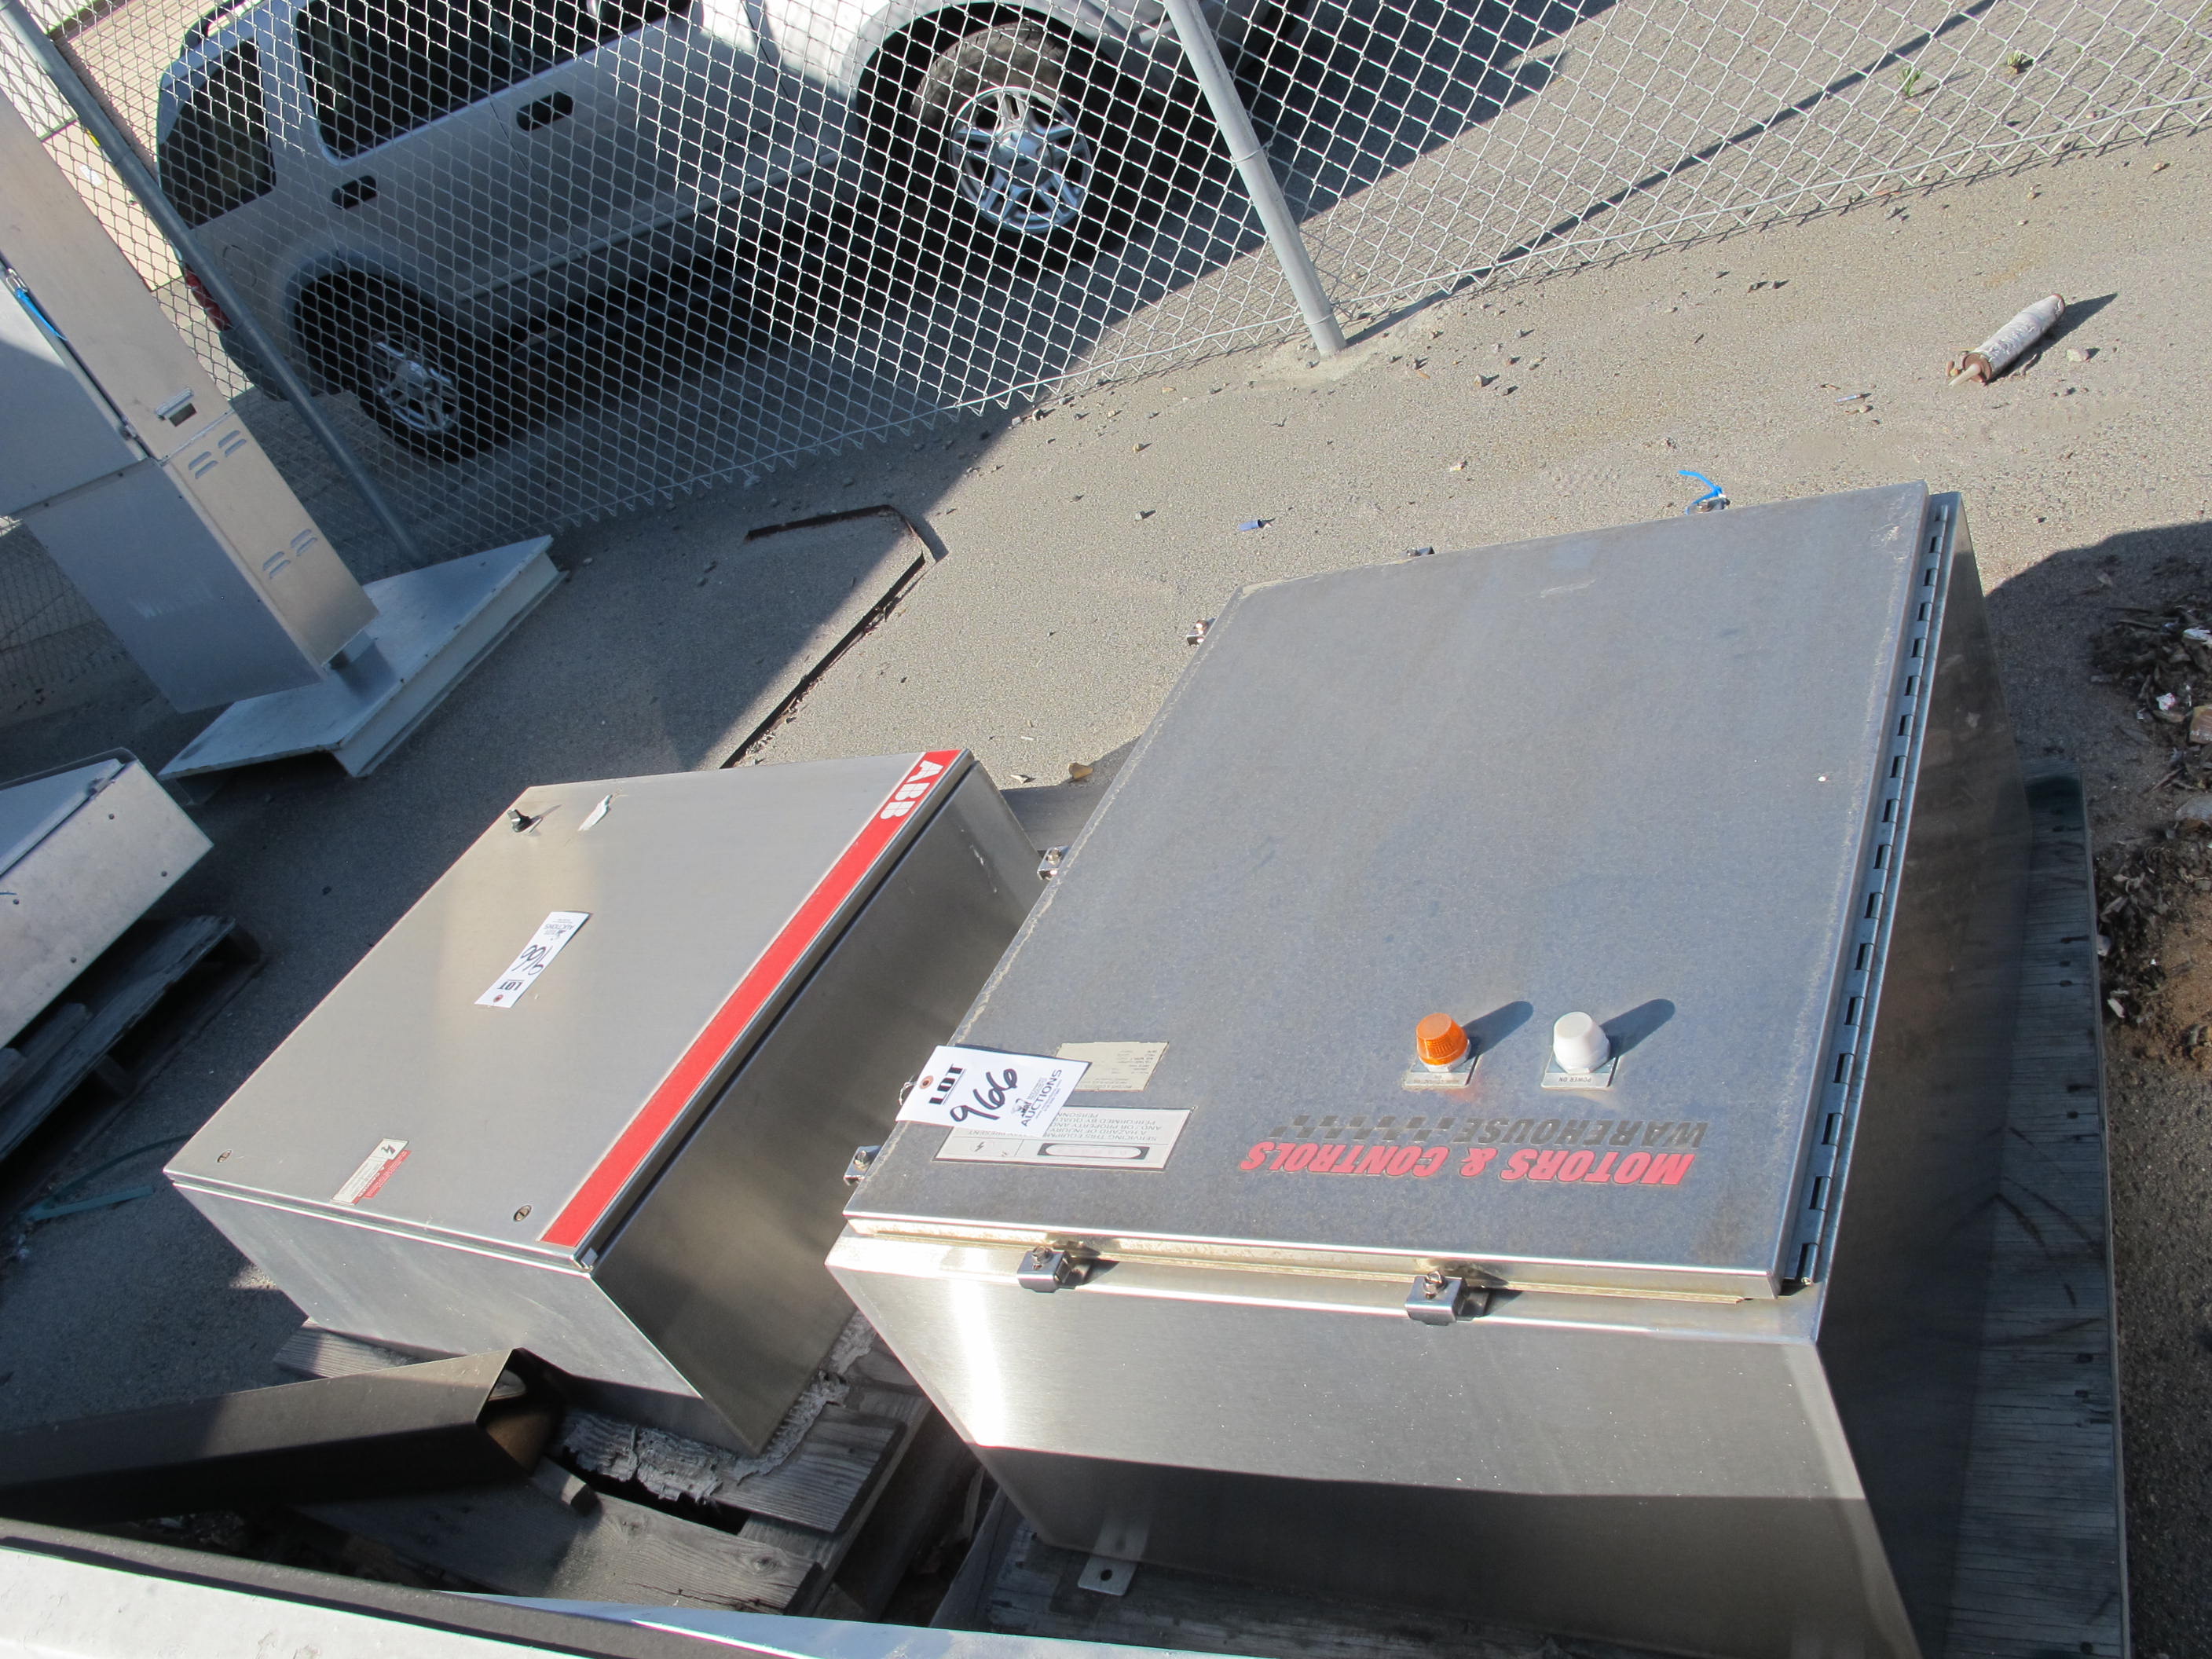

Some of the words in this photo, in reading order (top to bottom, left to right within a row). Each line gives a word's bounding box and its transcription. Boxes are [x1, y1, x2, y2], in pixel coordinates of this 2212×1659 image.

[880, 760, 944, 819] ABB
[497, 981, 523, 991] LOT
[928, 1064, 963, 1104] LOT
[950, 1068, 1018, 1122] 966
[1020, 1069, 1063, 1127] AUCTIONS
[1452, 1116, 1708, 1148] WAREHOUSE
[1240, 1141, 1451, 1177] CONTROLS
[1459, 1147, 1497, 1177] &
[1500, 1148, 1696, 1185] MOTORS
